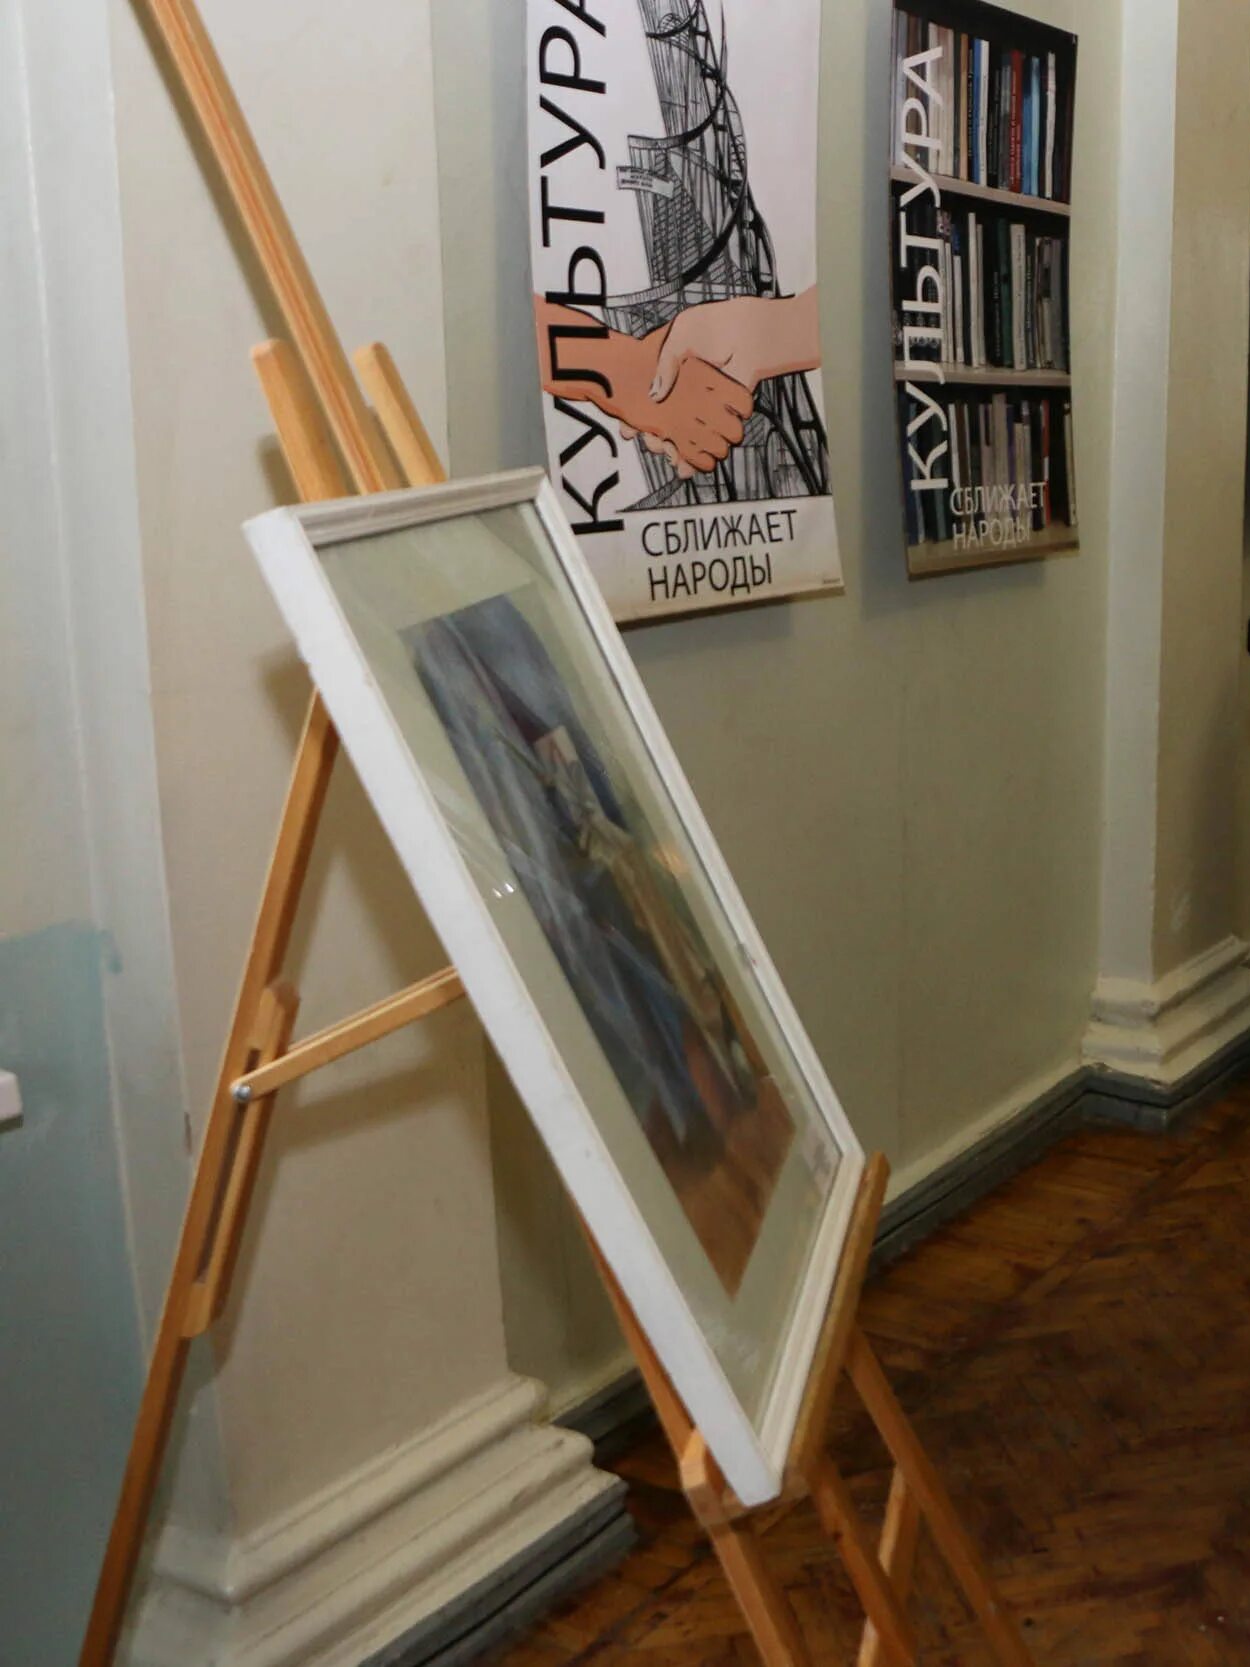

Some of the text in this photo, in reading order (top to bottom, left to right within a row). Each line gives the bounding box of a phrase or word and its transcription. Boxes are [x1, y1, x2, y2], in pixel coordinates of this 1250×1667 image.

[899, 46, 949, 490] КУЛЬТУРА
[950, 481, 1048, 516] СБЛИЖАЕТ
[641, 509, 797, 557] СБЛИЖАЕТ
[952, 517, 1032, 550] НАРОДЫ
[647, 552, 772, 601] НАРОДЫ
